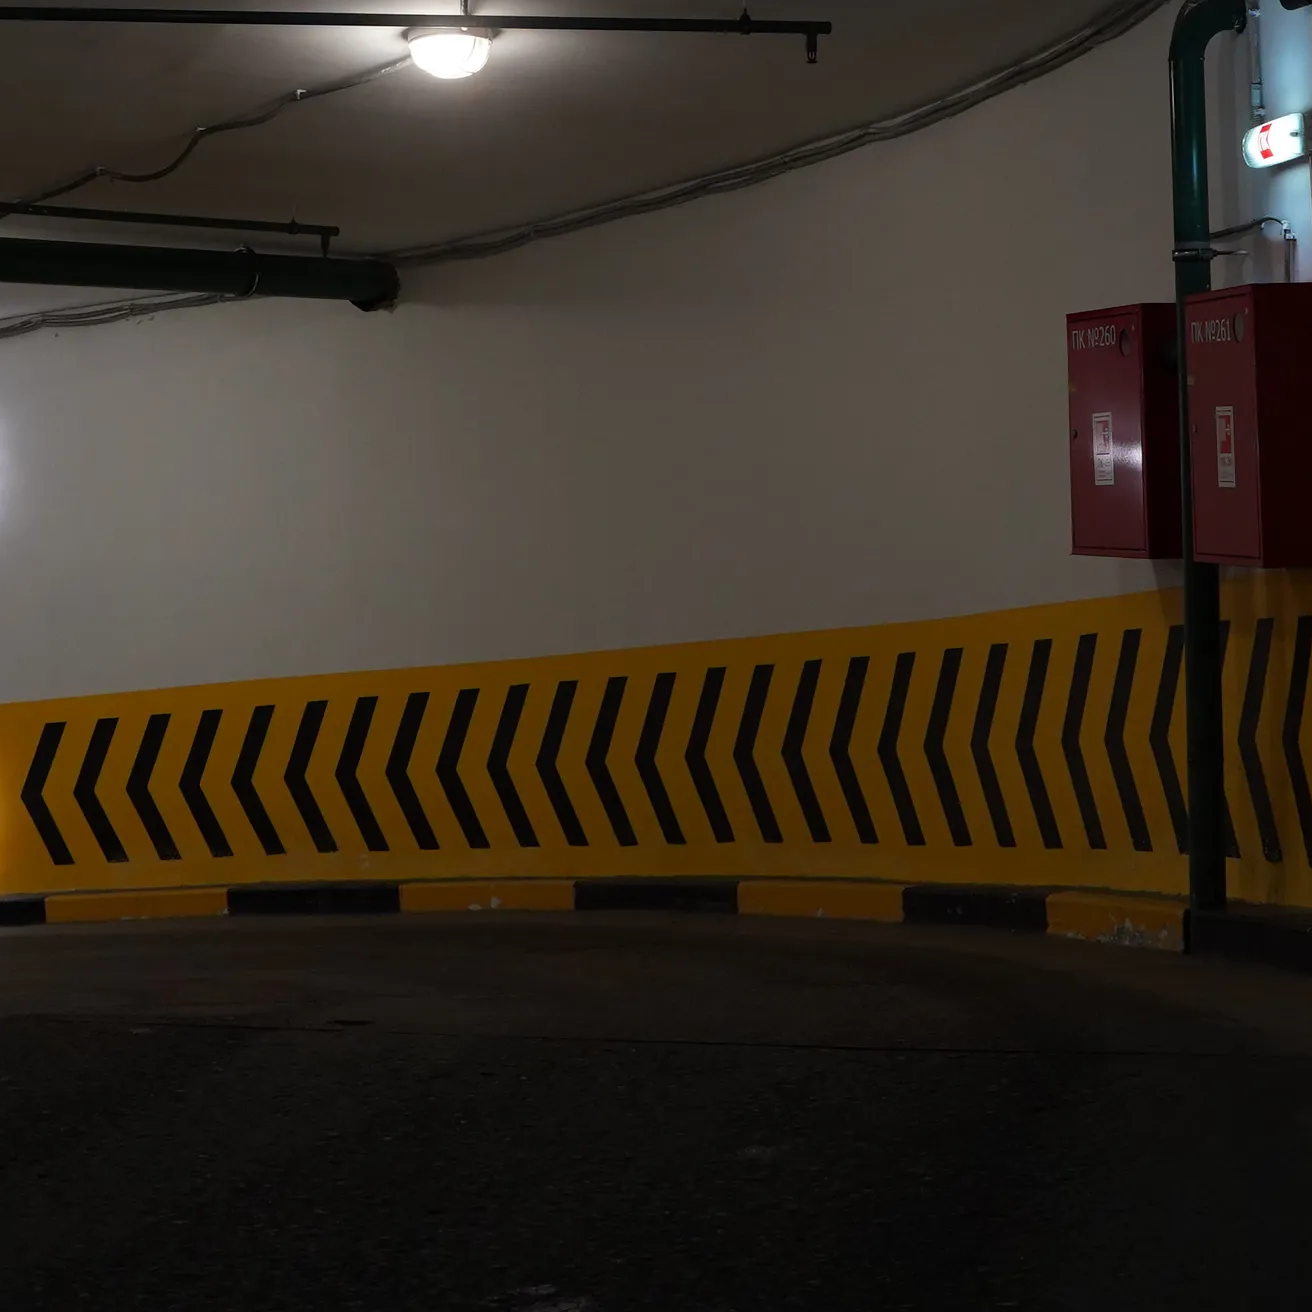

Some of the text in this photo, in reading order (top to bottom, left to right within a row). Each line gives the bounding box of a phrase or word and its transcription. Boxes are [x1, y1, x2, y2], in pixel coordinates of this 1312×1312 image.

[1072, 325, 1116, 350] ПК №260
[1191, 318, 1231, 343] ПК №261
